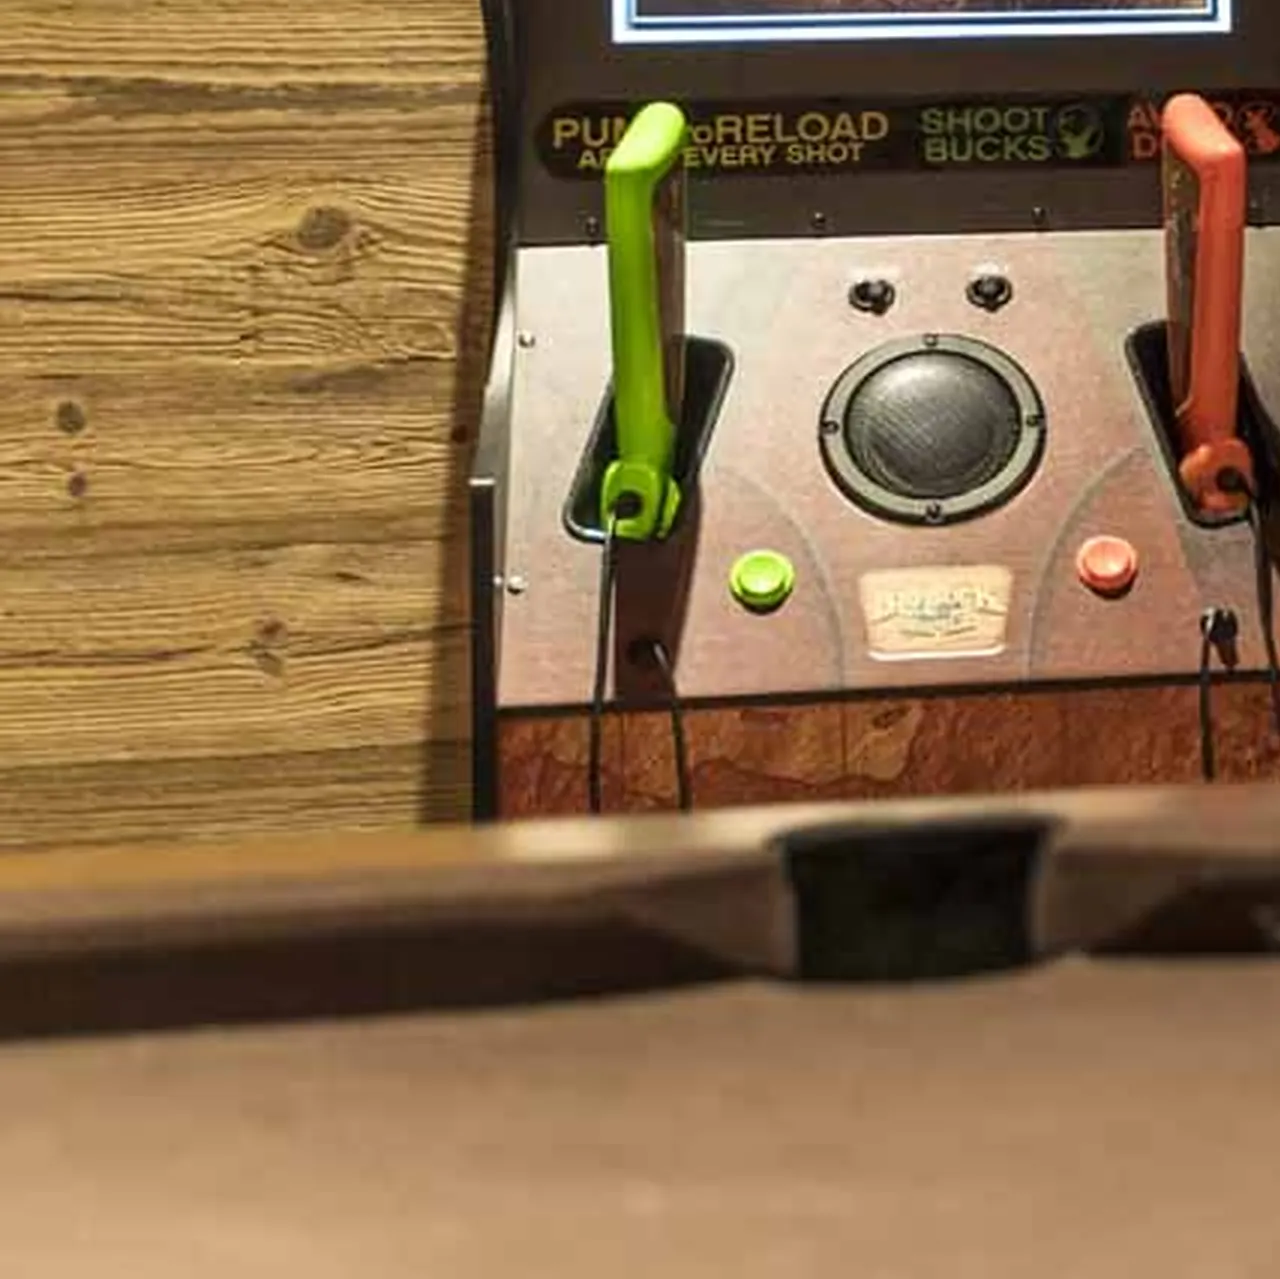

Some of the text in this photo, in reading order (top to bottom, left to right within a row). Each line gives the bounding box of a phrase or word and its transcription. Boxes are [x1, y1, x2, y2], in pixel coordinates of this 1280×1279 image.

[716, 111, 889, 144] RELOAD
[919, 106, 1048, 134] SHOOT
[683, 141, 865, 168] EVERY SHOT
[924, 135, 1051, 162] BUCKS
